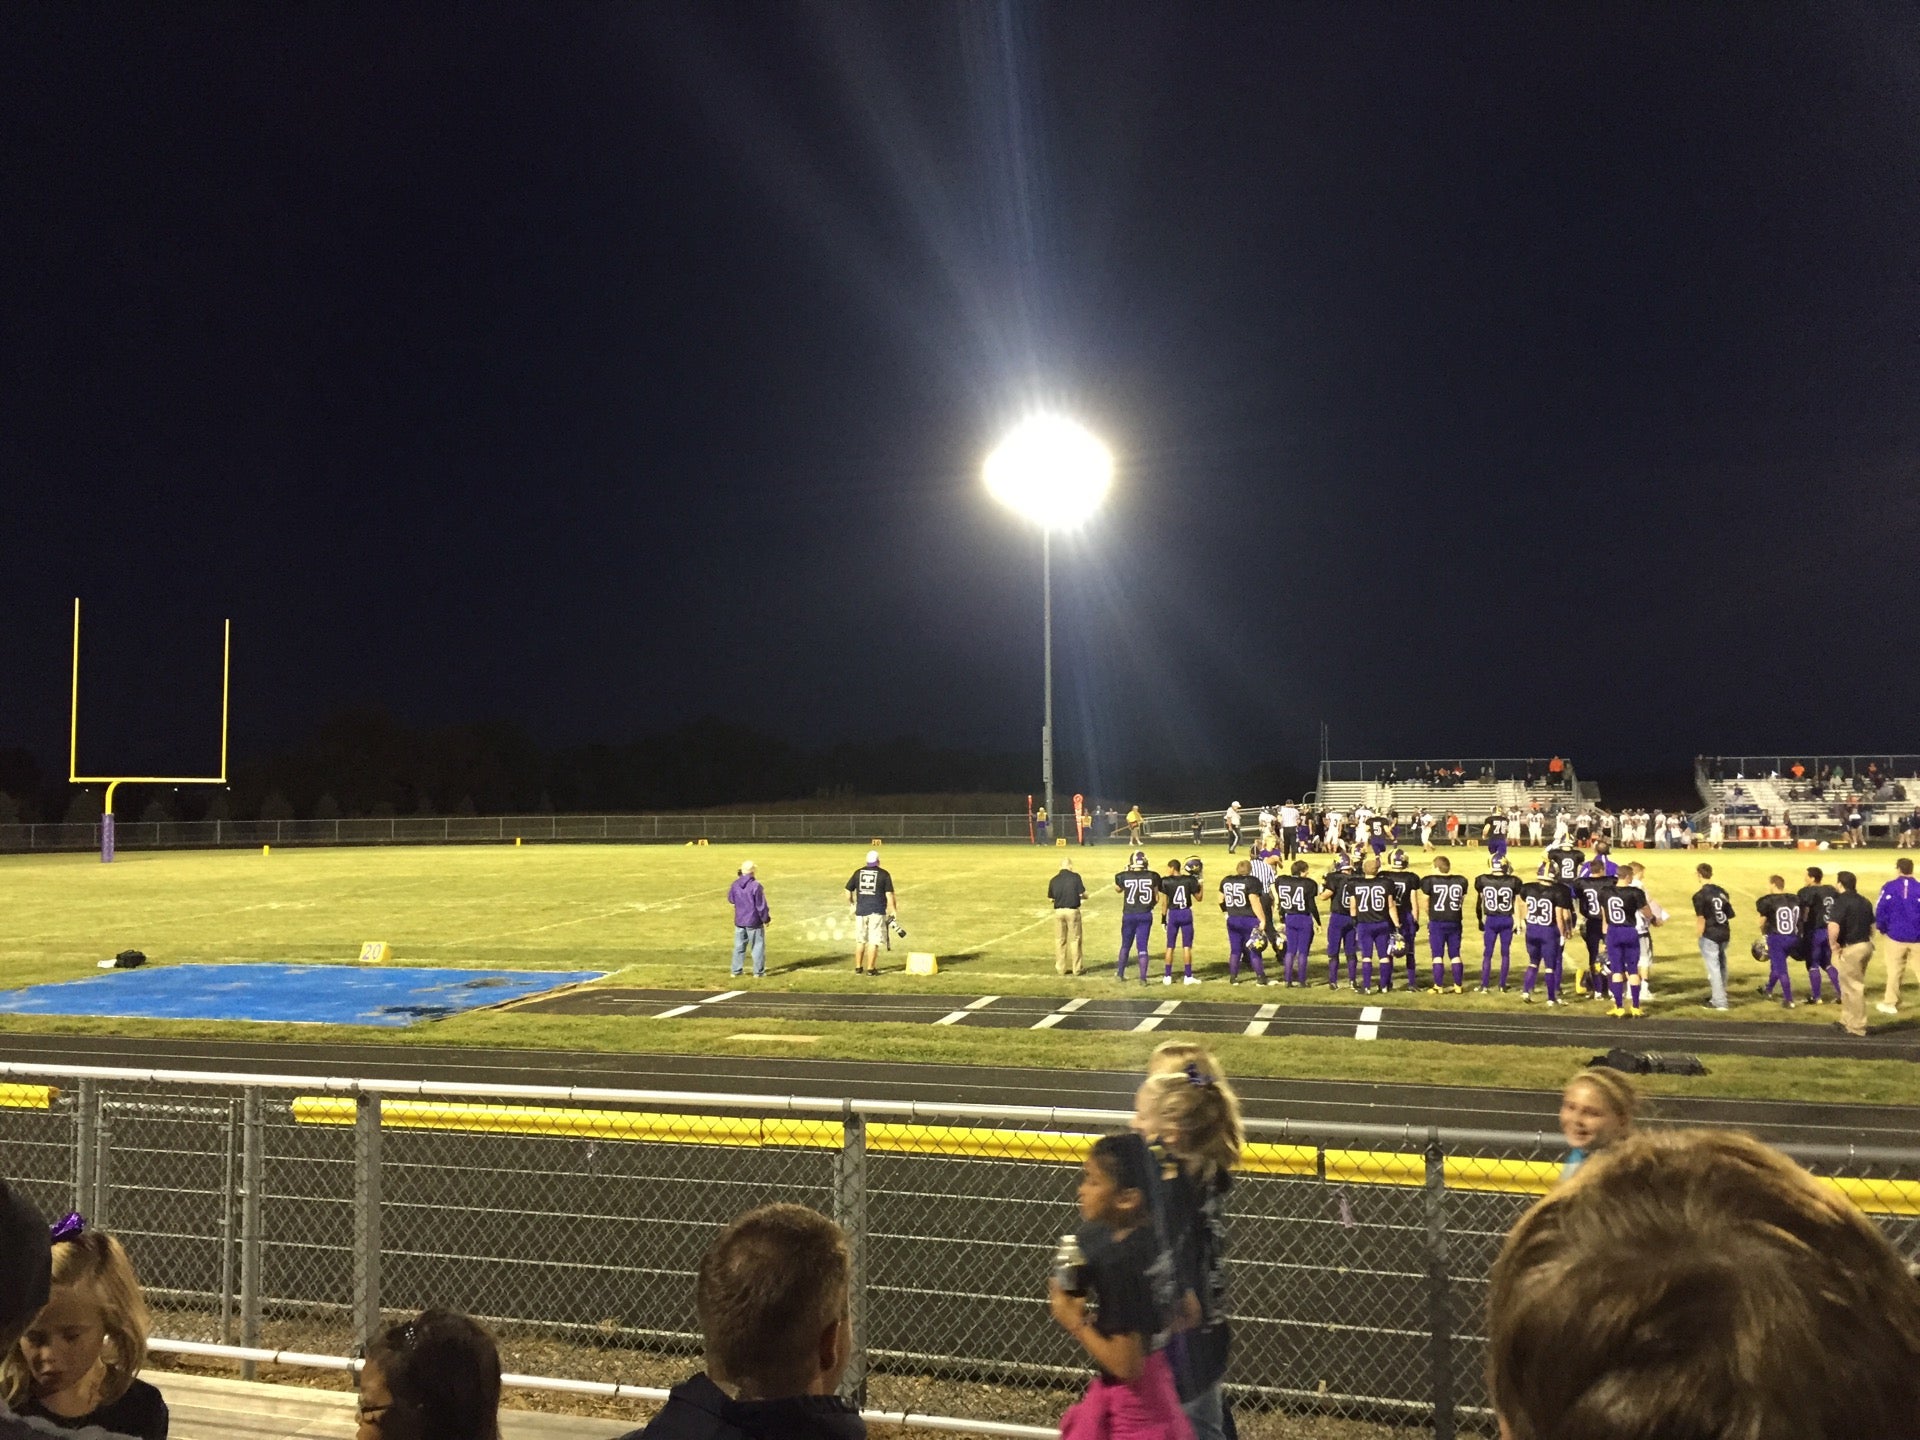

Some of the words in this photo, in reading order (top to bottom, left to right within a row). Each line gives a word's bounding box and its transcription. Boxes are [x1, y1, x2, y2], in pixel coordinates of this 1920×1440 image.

[1372, 821, 1382, 836] 5
[1561, 857, 1575, 879] 2
[1124, 878, 1153, 905] 75
[1173, 885, 1187, 909] 4
[1223, 882, 1246, 908] 65
[1278, 885, 1306, 911] 54
[1355, 885, 1386, 912] 76
[1433, 884, 1464, 911] 79
[1482, 886, 1514, 912] 83
[1525, 896, 1553, 926] 23
[1607, 896, 1626, 924] 6
[362, 943, 382, 961] 20
